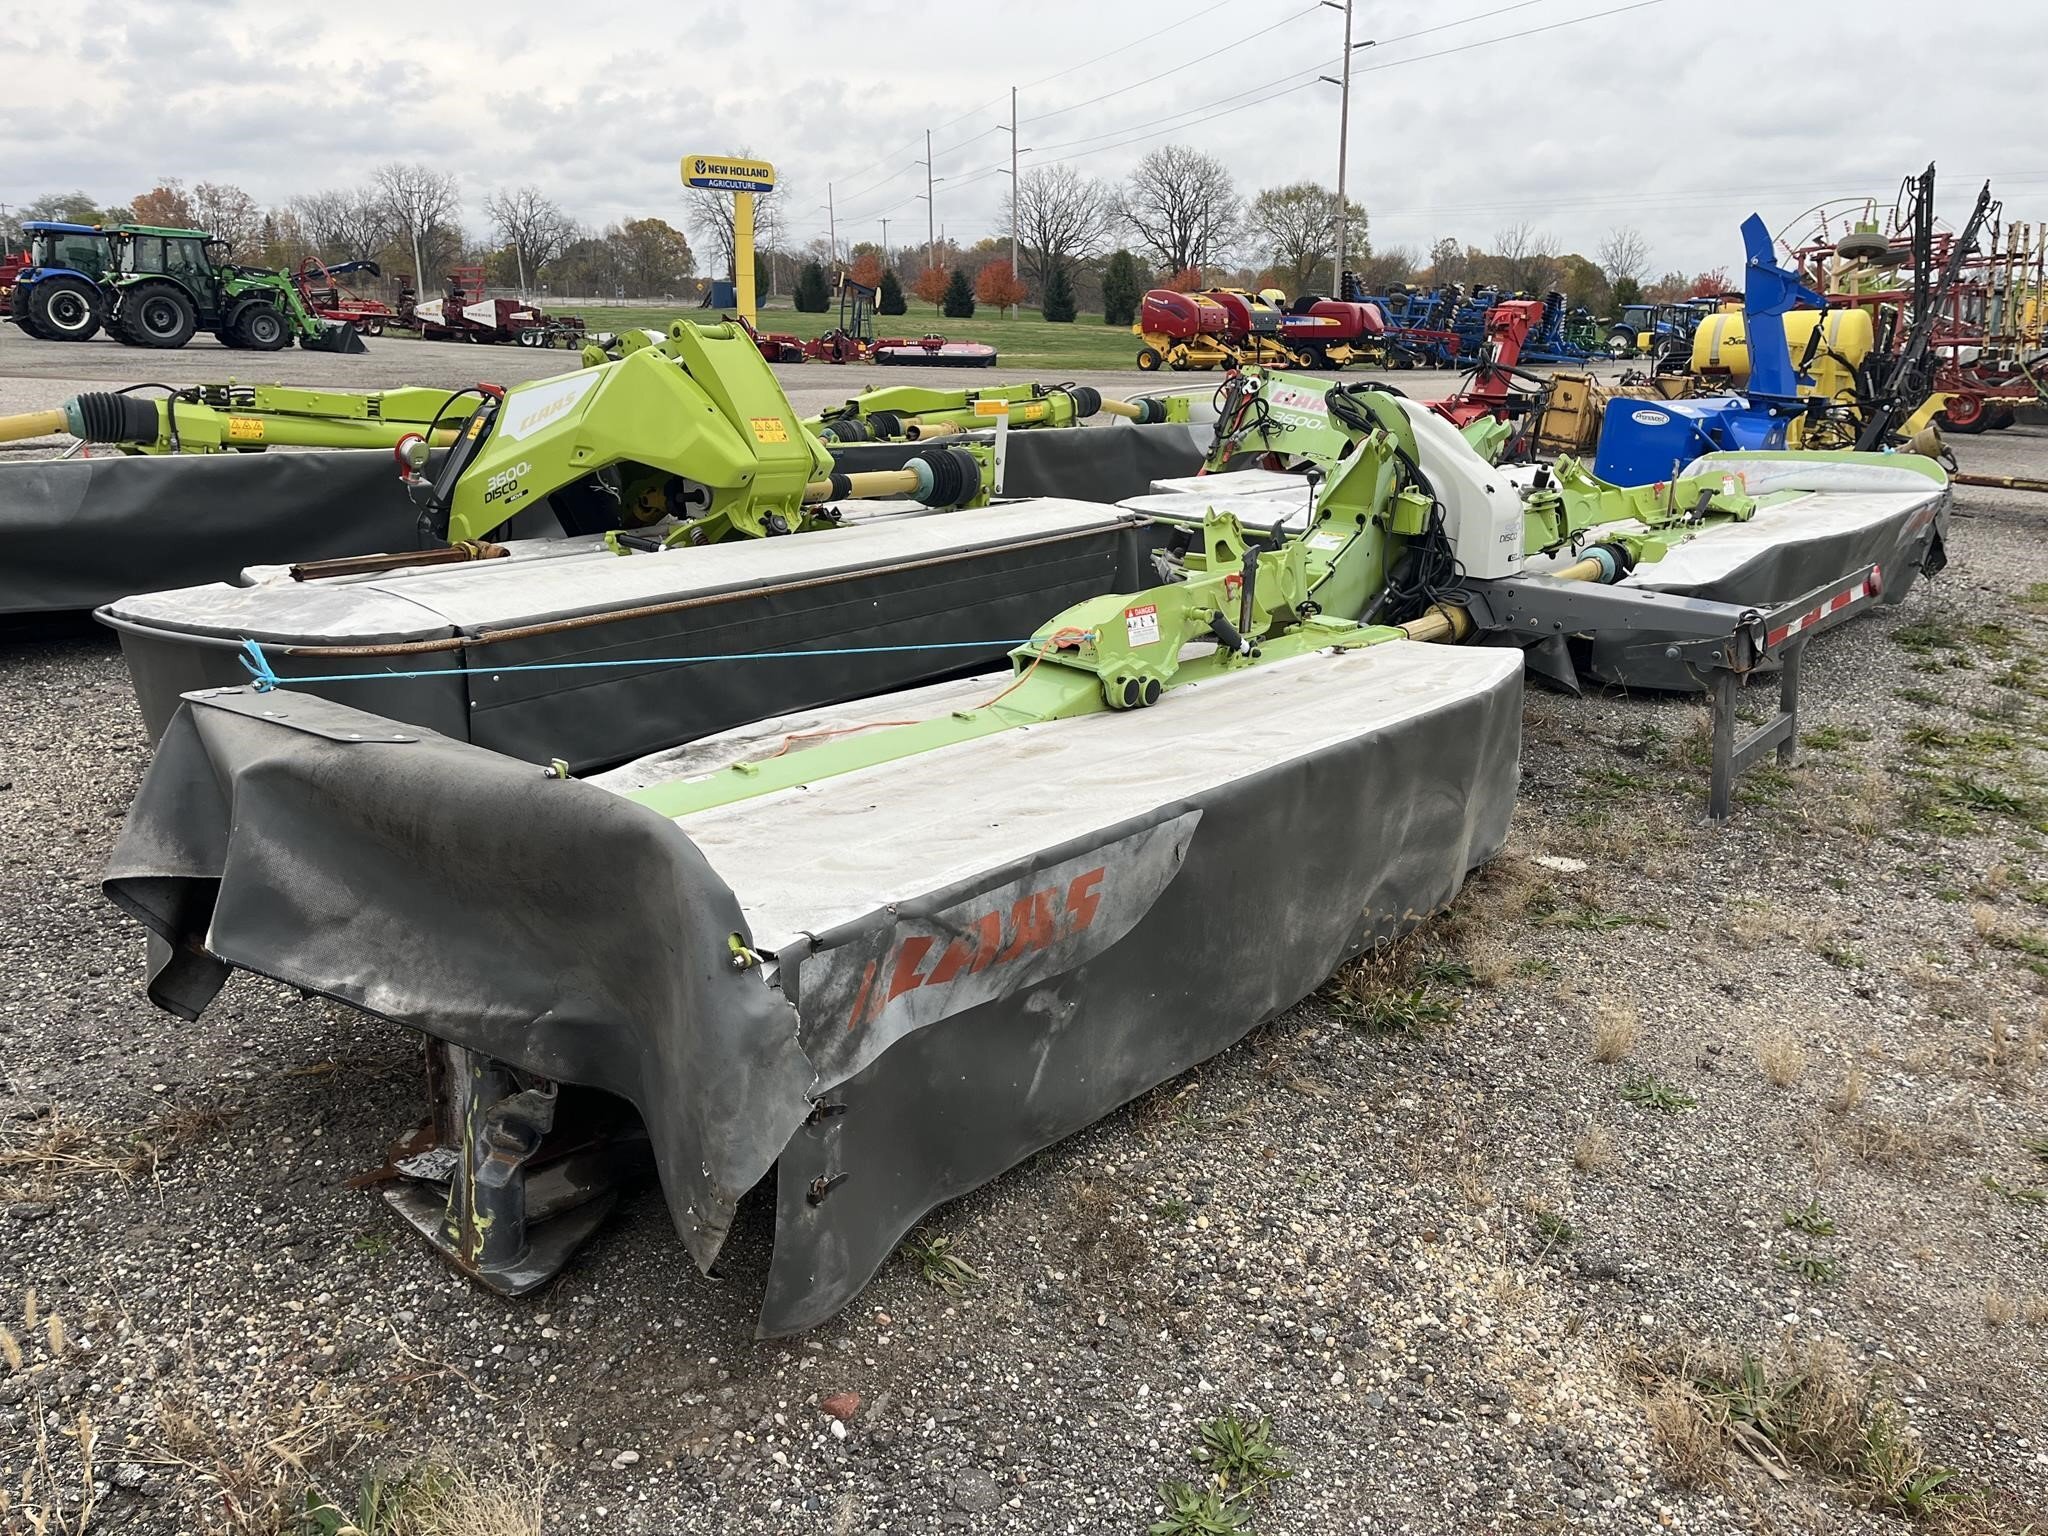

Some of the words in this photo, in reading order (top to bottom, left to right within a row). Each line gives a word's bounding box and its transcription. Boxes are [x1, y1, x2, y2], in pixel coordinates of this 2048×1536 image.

[708, 164, 728, 175] NEW
[729, 167, 769, 178] HOLLAND
[708, 179, 756, 190] AGRICULTURE
[1271, 389, 1328, 414] CLAA
[520, 391, 577, 433] CLAAS
[484, 480, 518, 504] DISCO
[1134, 605, 1155, 615] DANGER
